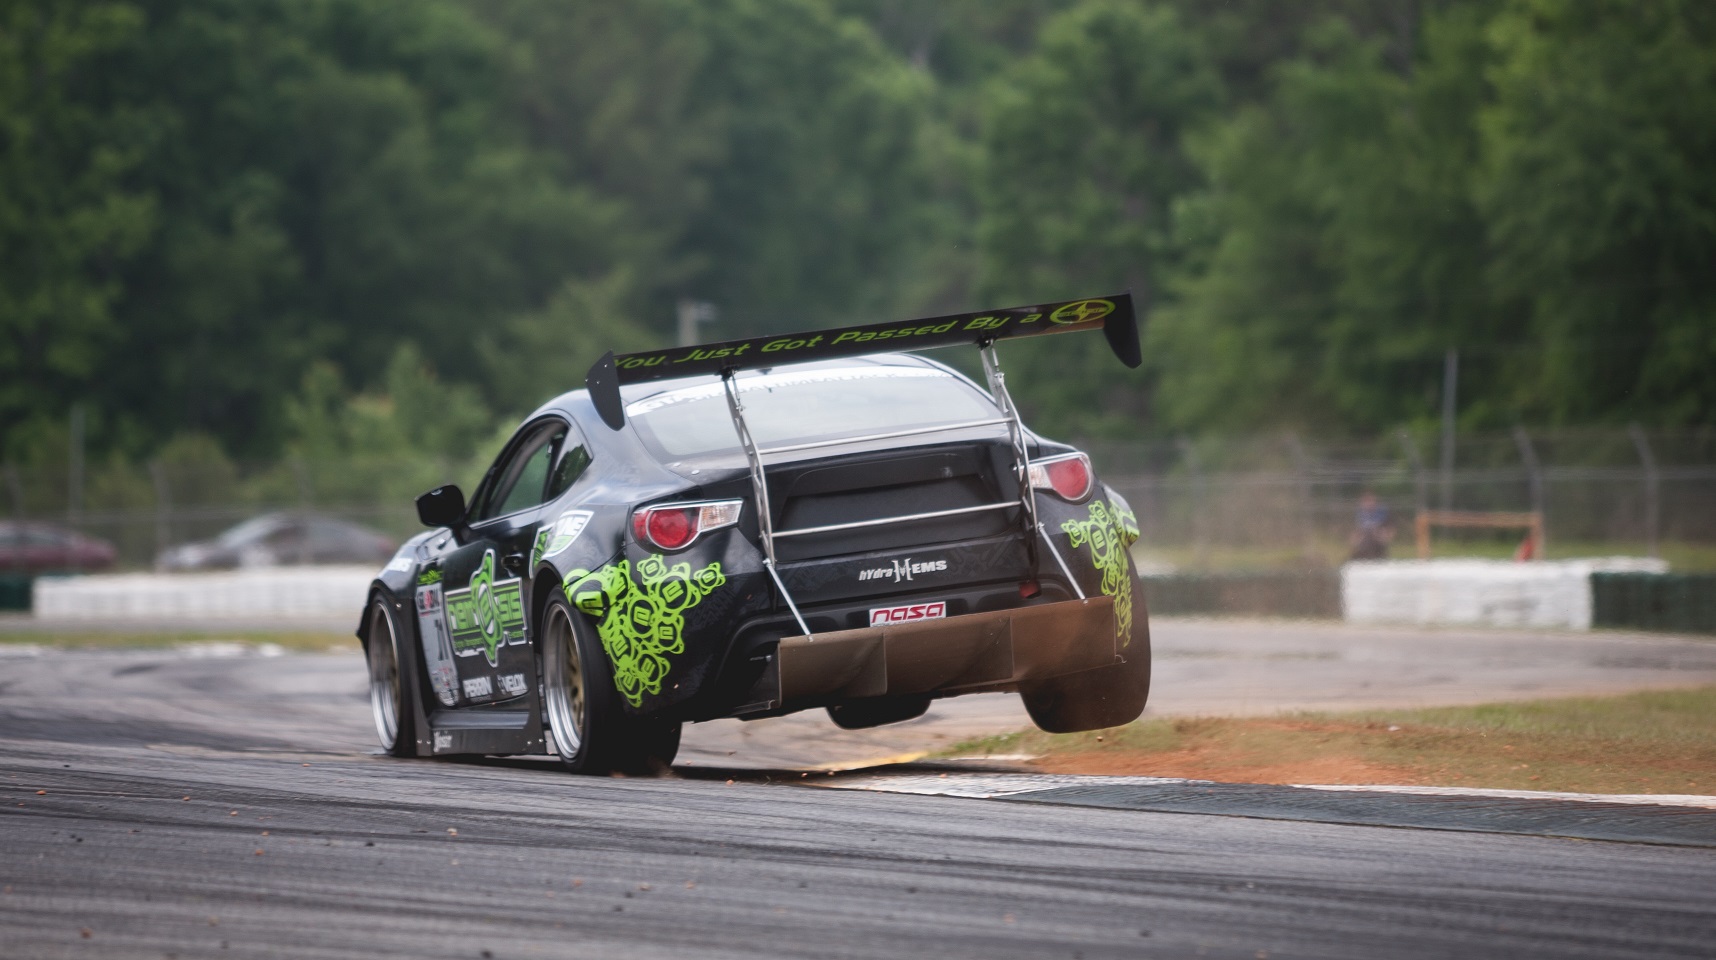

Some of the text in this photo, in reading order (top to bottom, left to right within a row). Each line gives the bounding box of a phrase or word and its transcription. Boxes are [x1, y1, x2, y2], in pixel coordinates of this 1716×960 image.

[614, 313, 1043, 370] You Just Got Passed By a
